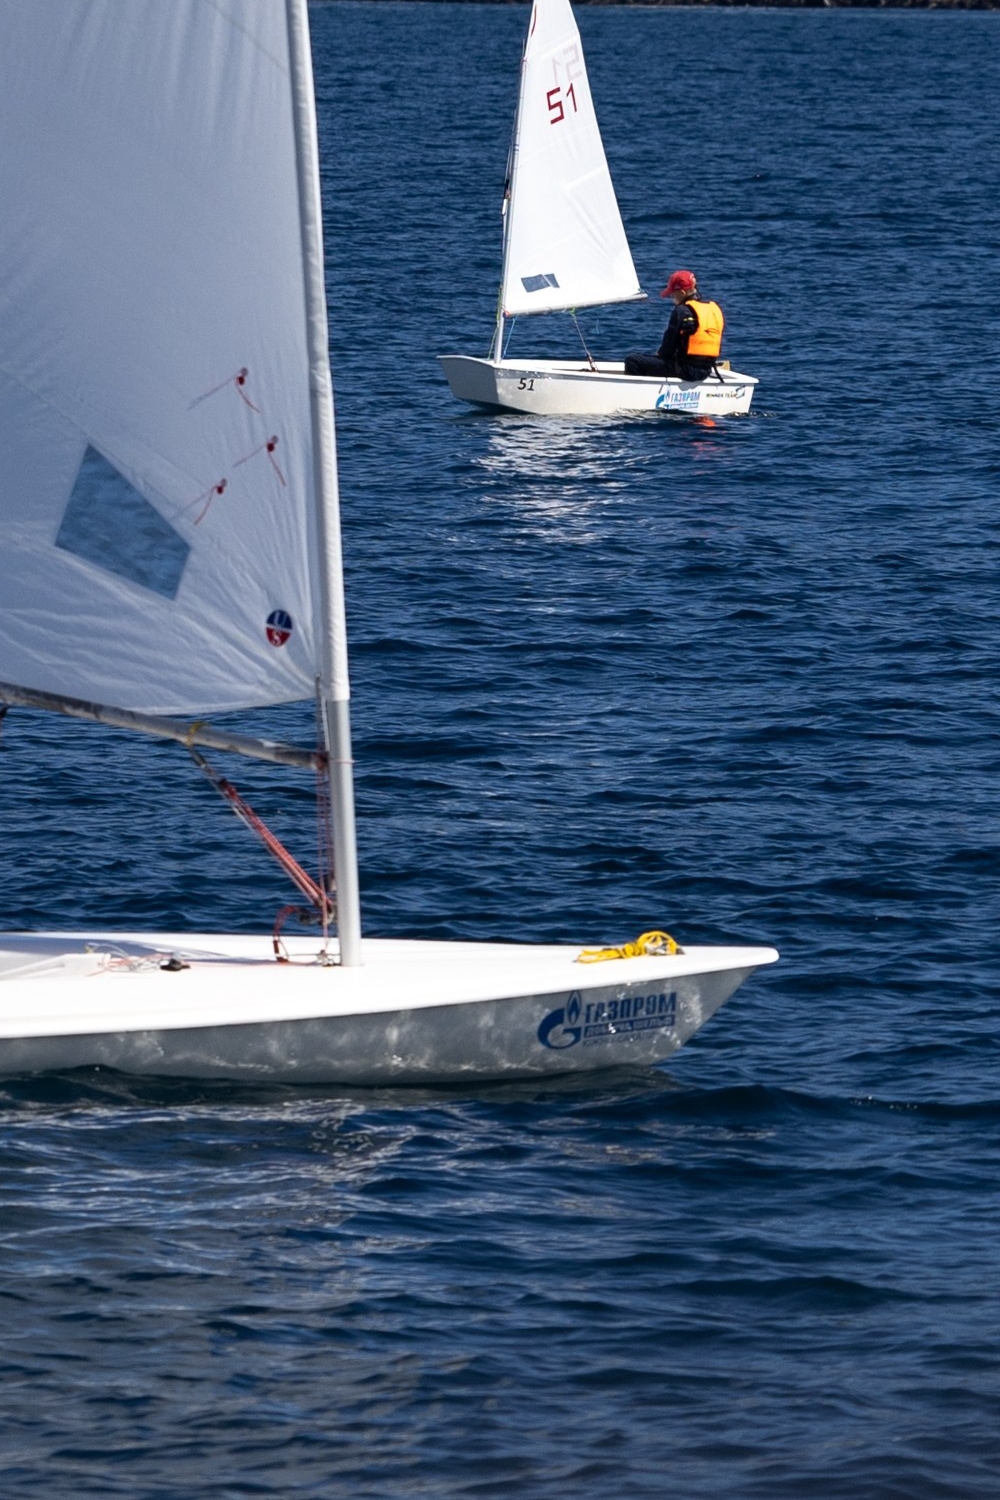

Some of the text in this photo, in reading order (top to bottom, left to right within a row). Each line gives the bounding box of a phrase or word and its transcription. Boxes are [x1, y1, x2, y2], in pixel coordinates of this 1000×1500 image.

[546, 82, 577, 125] 51
[517, 377, 534, 391] 51
[671, 391, 700, 403] ГАЗПРОМ
[585, 992, 677, 1024] ГАЗПРОМ
